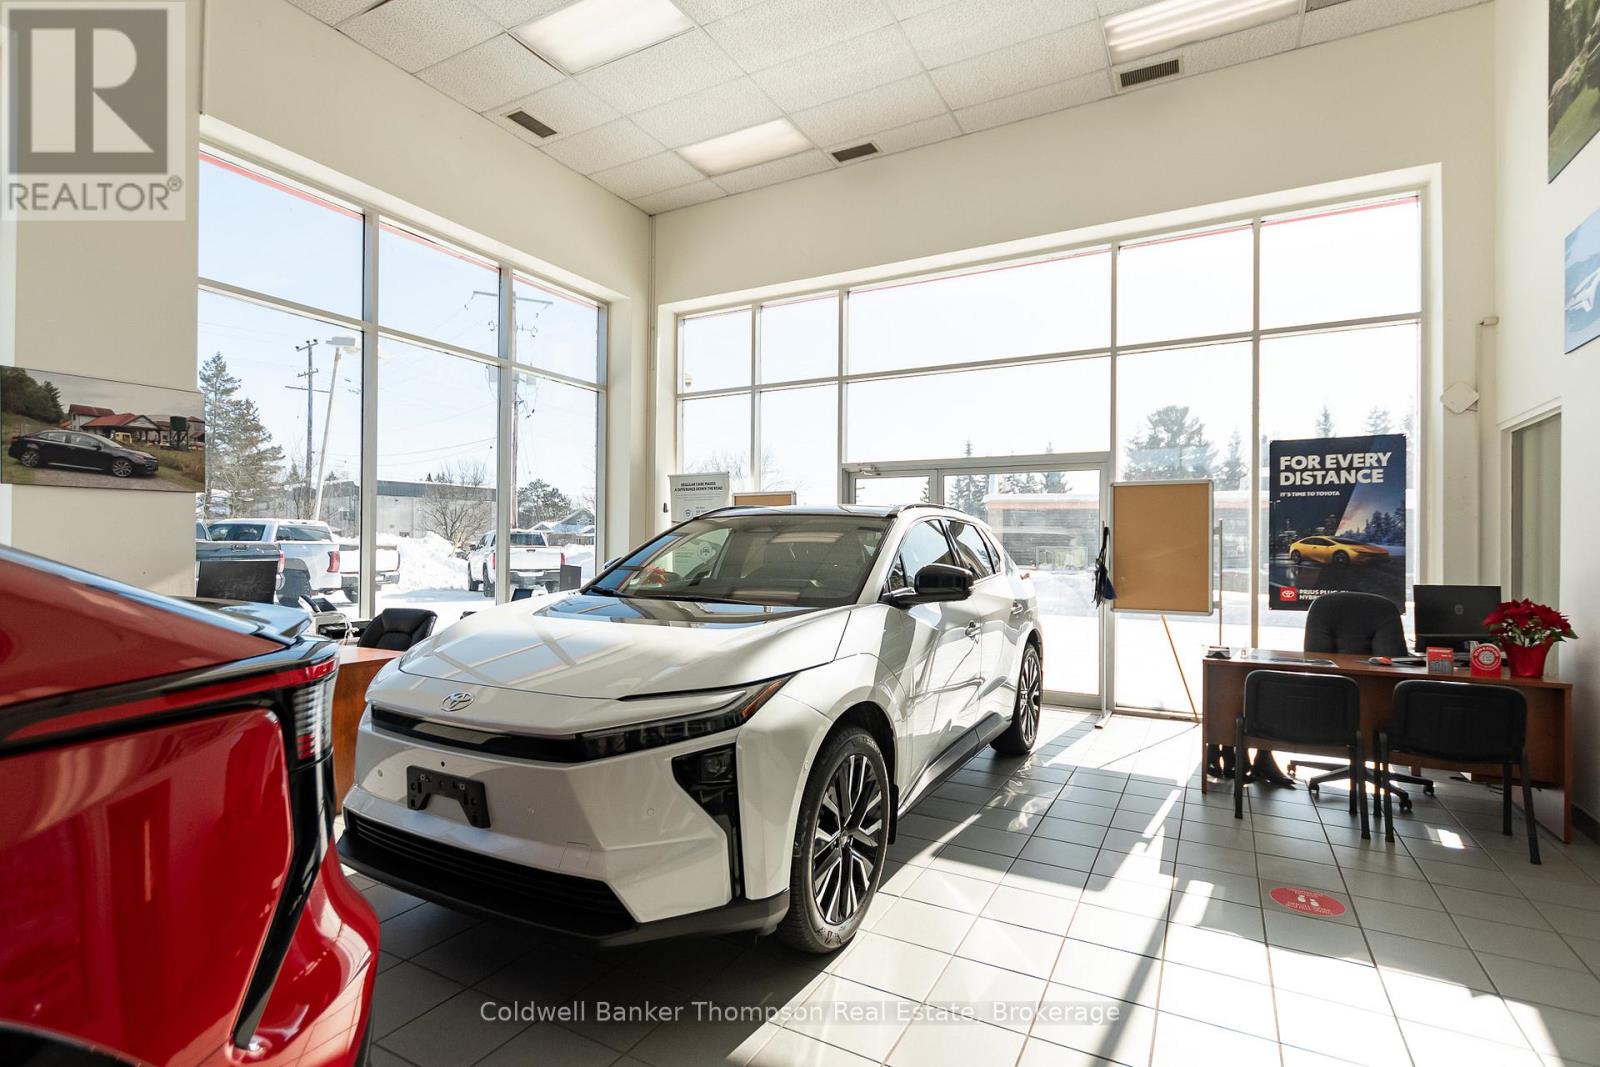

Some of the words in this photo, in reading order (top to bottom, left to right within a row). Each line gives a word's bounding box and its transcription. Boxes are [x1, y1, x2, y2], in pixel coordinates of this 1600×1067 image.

[1279, 455, 1321, 470] FOR
[1325, 452, 1392, 468] EVERY
[1279, 469, 1384, 486] DISTANCE
